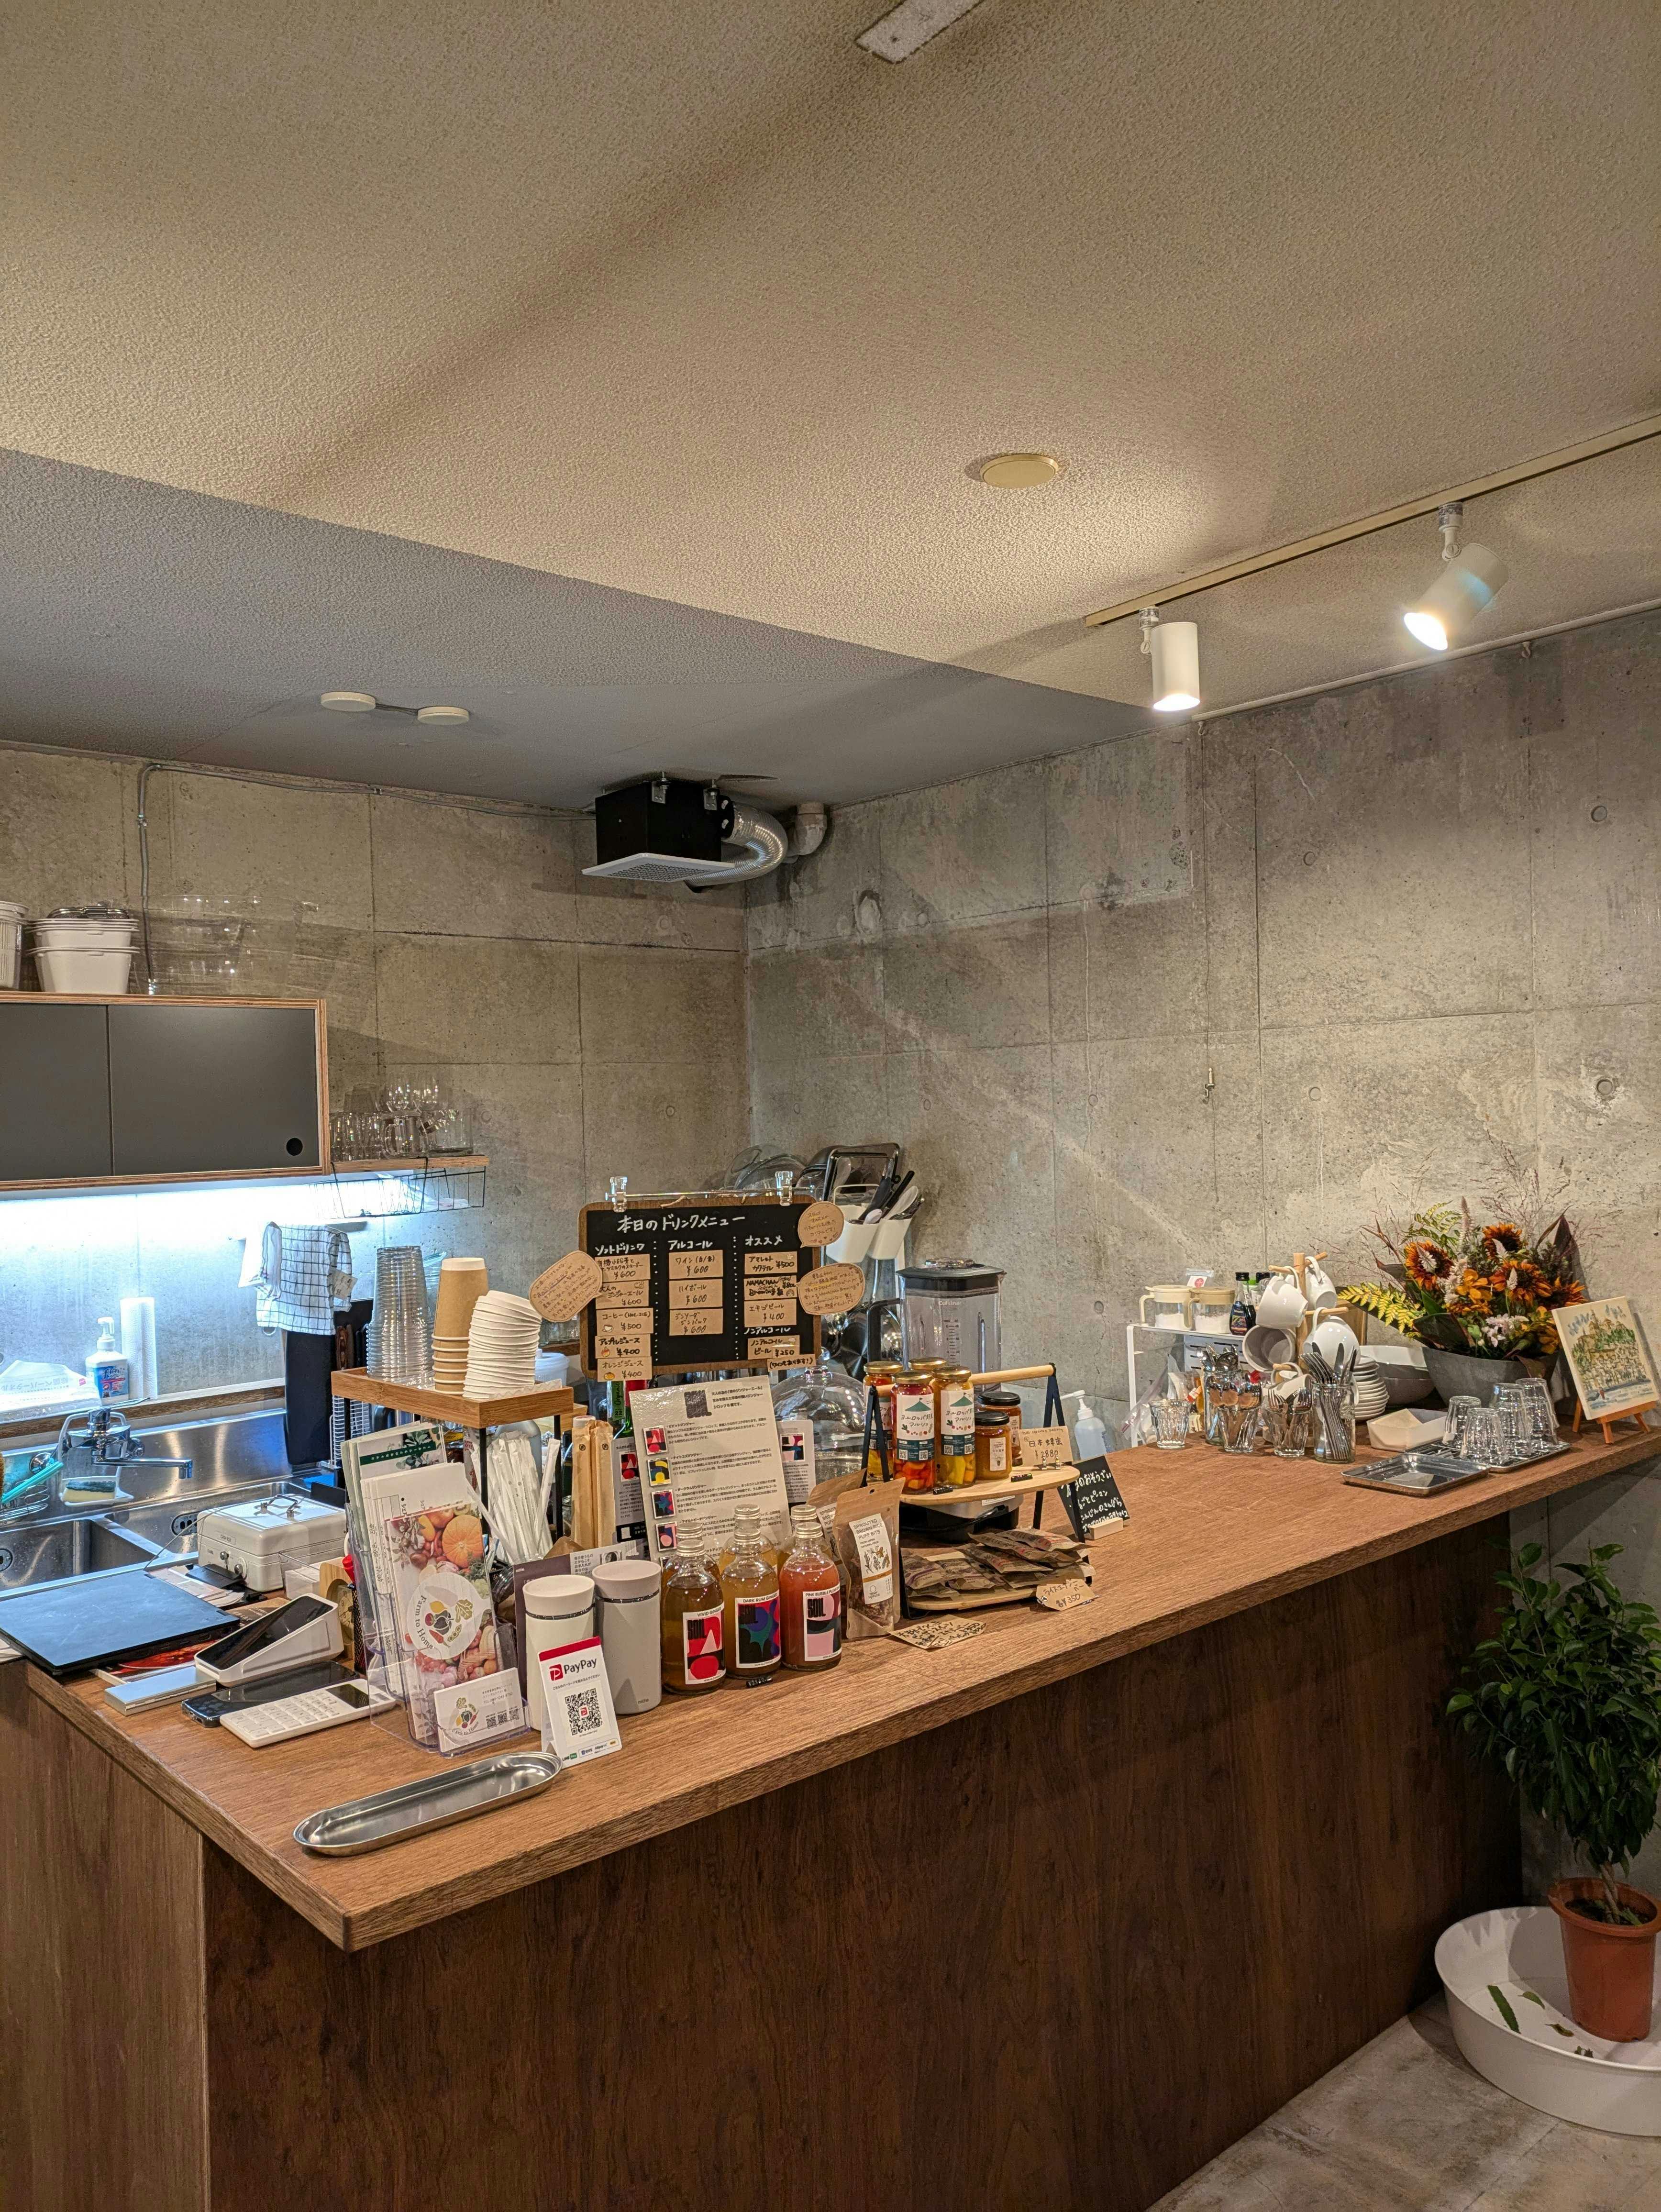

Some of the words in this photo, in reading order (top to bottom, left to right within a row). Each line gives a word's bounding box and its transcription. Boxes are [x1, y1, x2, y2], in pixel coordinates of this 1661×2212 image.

[616, 1213, 745, 1233] 本日のドリンクメニュー
[667, 1239, 713, 1250] アルコール
[745, 1235, 783, 1246] オススメ
[595, 1242, 645, 1255] ソフトドリンク
[775, 1261, 795, 1269] ¥500
[679, 1284, 707, 1293] ハイボール
[620, 1322, 642, 1331] ¥500
[743, 1327, 791, 1335] ノンアルコール
[616, 1348, 640, 1357] ¥400
[754, 1347, 772, 1355] ビール
[775, 1349, 795, 1357] ¥250
[602, 1360, 643, 1369] オレンジジュース
[621, 1371, 642, 1379] ¥400
[853, 1518, 877, 1529] SPROUTED
[856, 1526, 873, 1534] BROWN
[415, 1595, 427, 1616] Farm
[807, 1598, 826, 1618] SOIL
[415, 1619, 421, 1627] to
[417, 1628, 433, 1649] Home
[564, 1658, 597, 1674] PayPay
